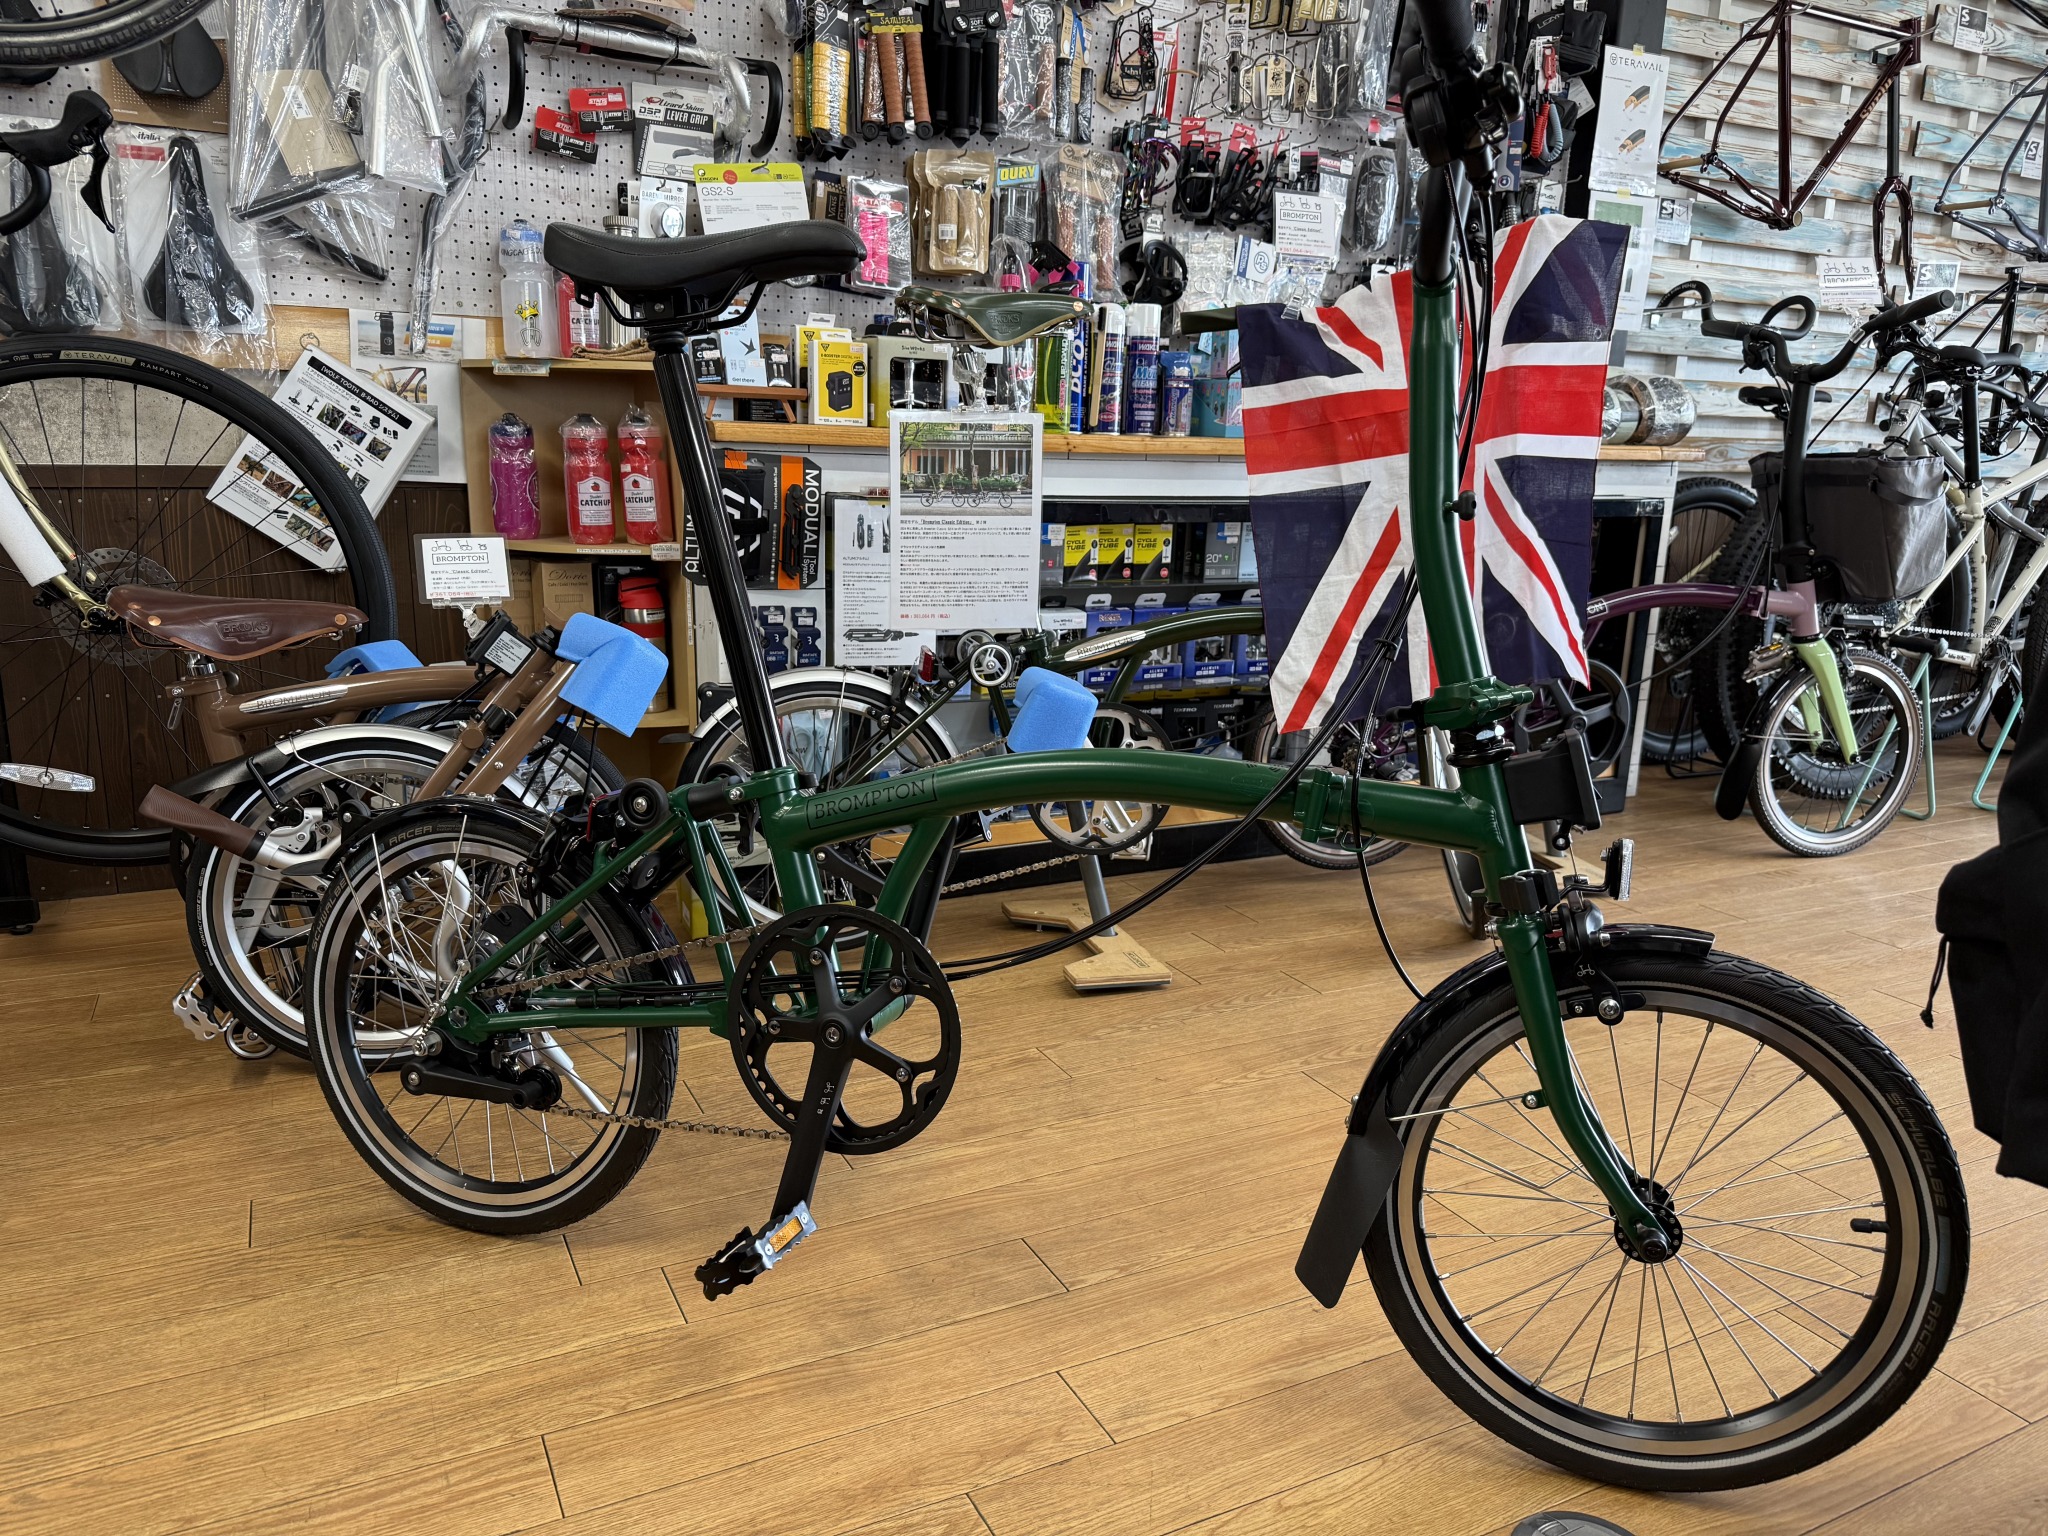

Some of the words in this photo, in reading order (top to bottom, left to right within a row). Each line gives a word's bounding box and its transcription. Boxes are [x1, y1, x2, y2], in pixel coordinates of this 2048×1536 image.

[880, 16, 914, 25] SAMURAI
[1618, 58, 1664, 73] TERAVAIL
[659, 99, 684, 109] Lizard
[682, 103, 705, 113] Skins
[667, 110, 688, 123] LEVER
[689, 114, 708, 125] GRIP
[138, 132, 161, 141] italia
[1000, 165, 1036, 181] OURY
[664, 194, 685, 203] MIRROR
[701, 187, 734, 196] GS2-S
[829, 196, 837, 217] VANS
[1282, 212, 1319, 221] BROMPTON
[74, 352, 131, 365] TERAVAIL
[140, 362, 182, 378] RAMPART
[340, 377, 359, 393] TOOTH
[803, 469, 820, 556] MODUAL
[435, 555, 485, 563] BROMPTON
[222, 620, 269, 633] BROOKS
[813, 778, 927, 820] BROMPTON
[388, 825, 433, 847] RACER
[312, 877, 348, 952] SCHWALBE
[1888, 1090, 1949, 1209] SCHWALBE
[1904, 1299, 1943, 1371] RACER
